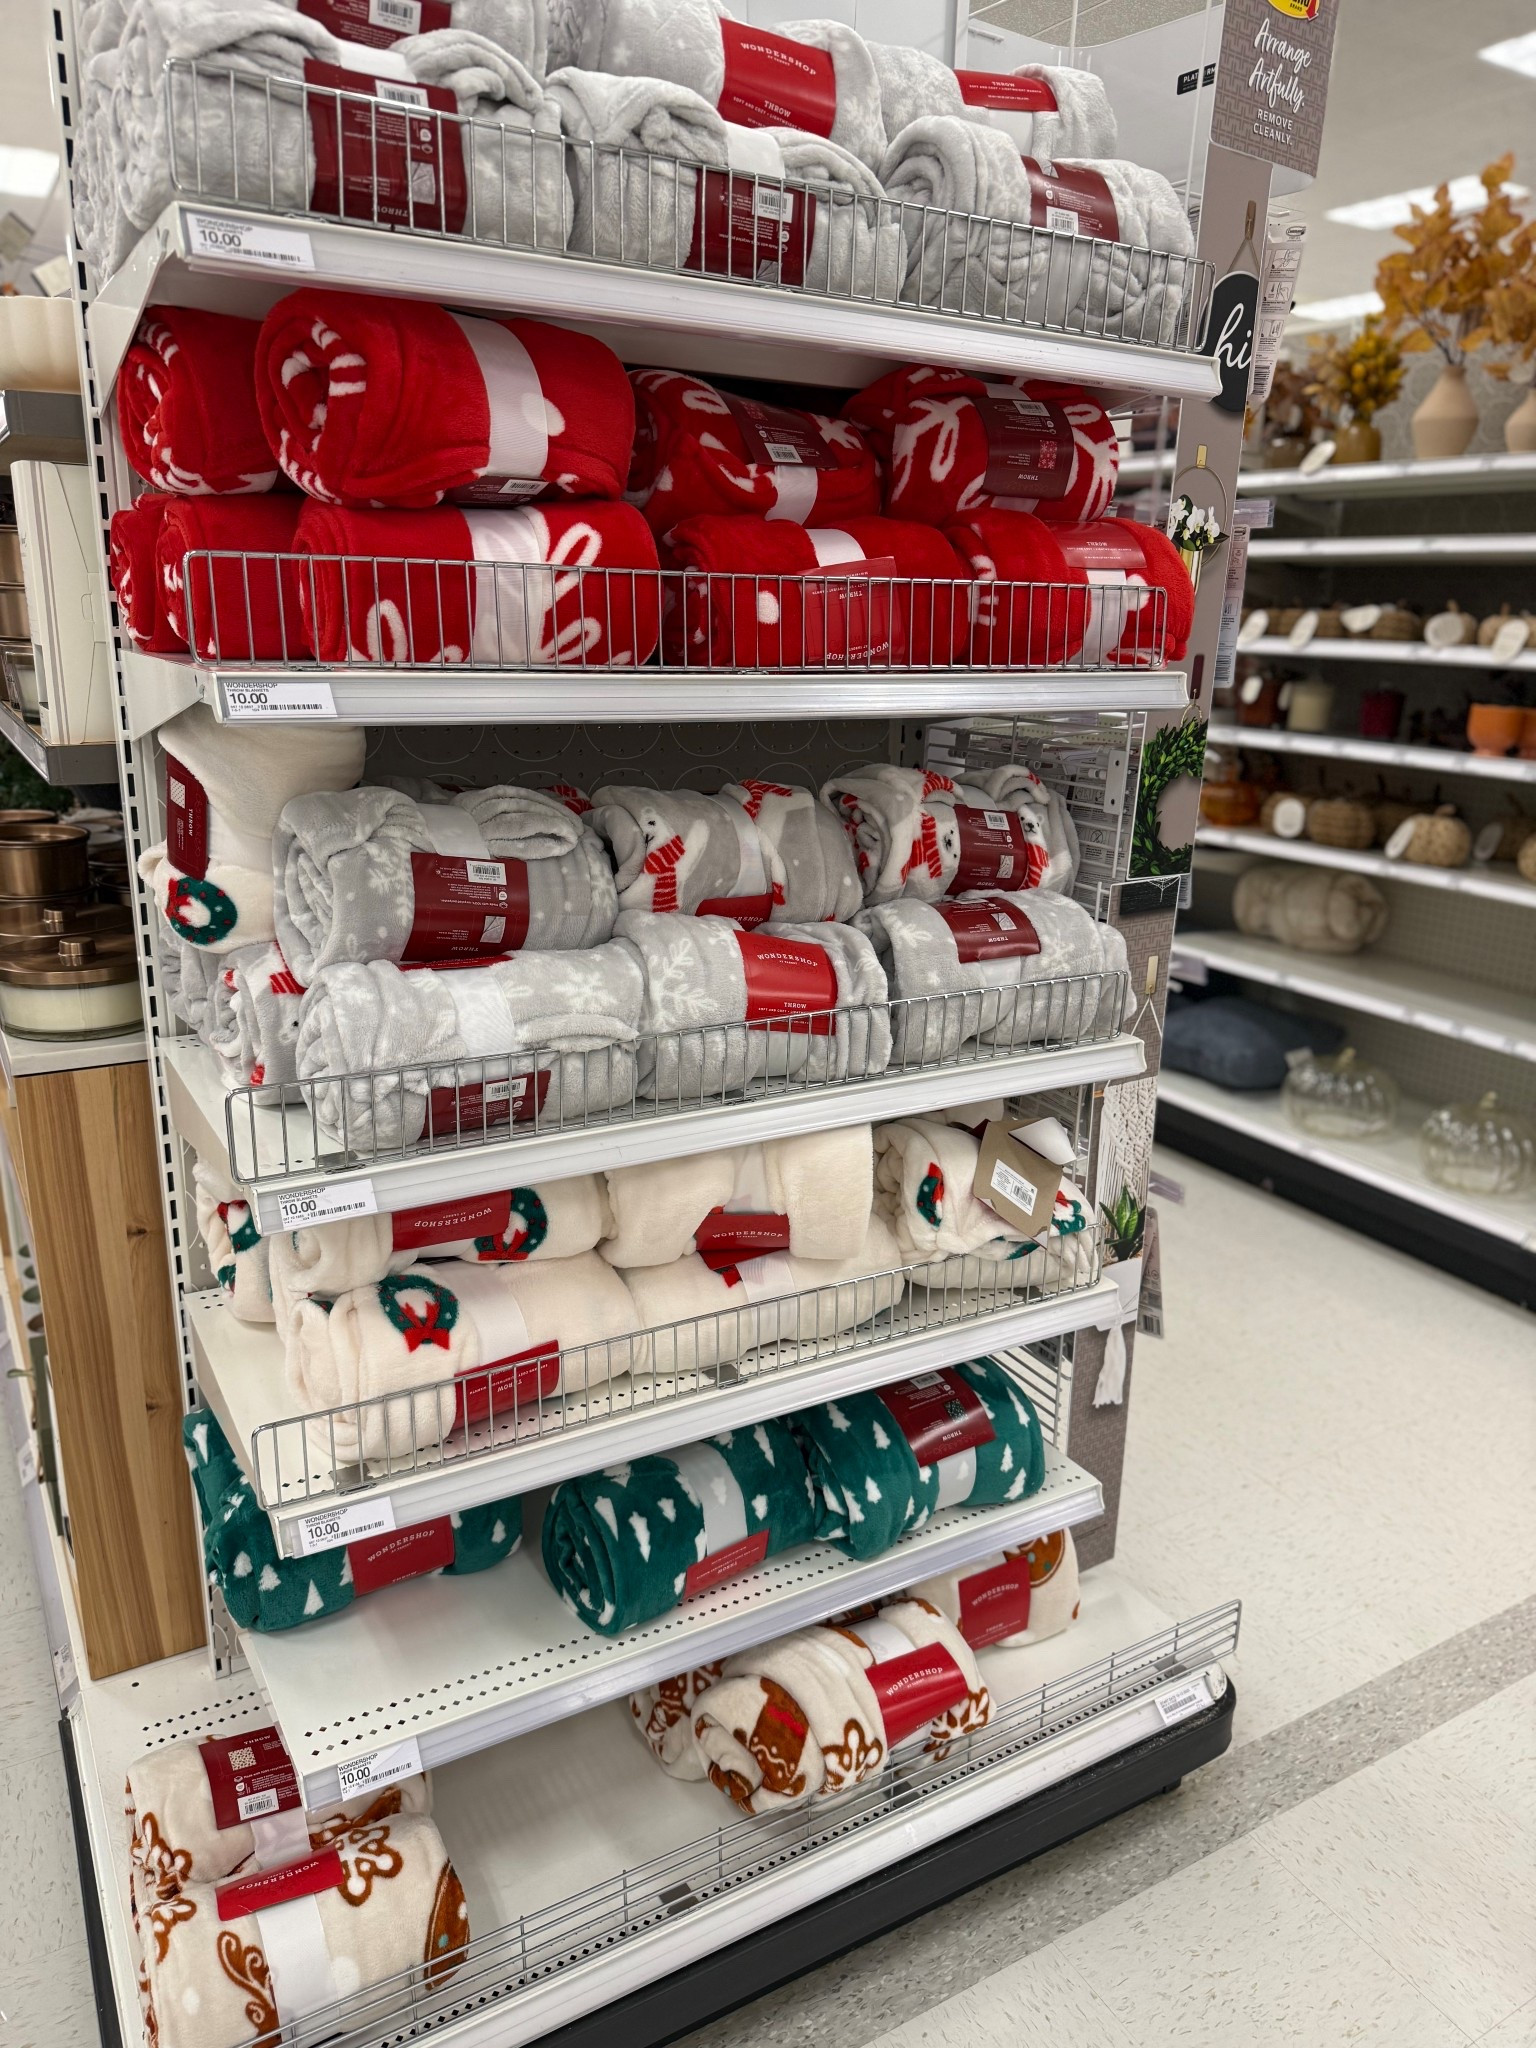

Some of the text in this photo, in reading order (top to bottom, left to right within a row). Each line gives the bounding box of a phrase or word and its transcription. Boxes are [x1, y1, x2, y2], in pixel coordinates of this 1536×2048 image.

[1254, 17, 1312, 74] Arrange
[740, 42, 817, 76] WONDERSHOP
[1248, 57, 1305, 114] Artfully.
[763, 100, 791, 118] THROW
[1257, 108, 1294, 131] REMOVE
[1253, 122, 1293, 146] CLEANLY.
[200, 229, 242, 248] 10.00
[229, 692, 268, 704] 10.00
[988, 935, 1009, 943] THROW
[757, 953, 818, 967] WONDERSHOP
[783, 1001, 807, 1009] THROW
[279, 1188, 326, 1200] WONDERSHOP
[282, 1200, 317, 1216] 10.00
[414, 1207, 492, 1228] WONDERSHOP
[712, 1230, 783, 1238] WONDERSHOP
[497, 1379, 523, 1392] TROW
[943, 1430, 962, 1441] THROW
[304, 1508, 348, 1524] WONDERSHOP
[308, 1521, 340, 1539] 10.00
[367, 1529, 435, 1562] WONDERSHOP
[392, 1570, 417, 1583] THROW
[717, 1561, 738, 1574] THROW
[971, 1583, 1020, 1606] WONDERSHOP
[886, 1666, 943, 1697] WONDERSHOP
[243, 1734, 272, 1745] THROW
[338, 1752, 378, 1771] WONDERSHOP
[341, 1766, 371, 1786] 10.00
[238, 1861, 319, 1891] WONDERSHOP
